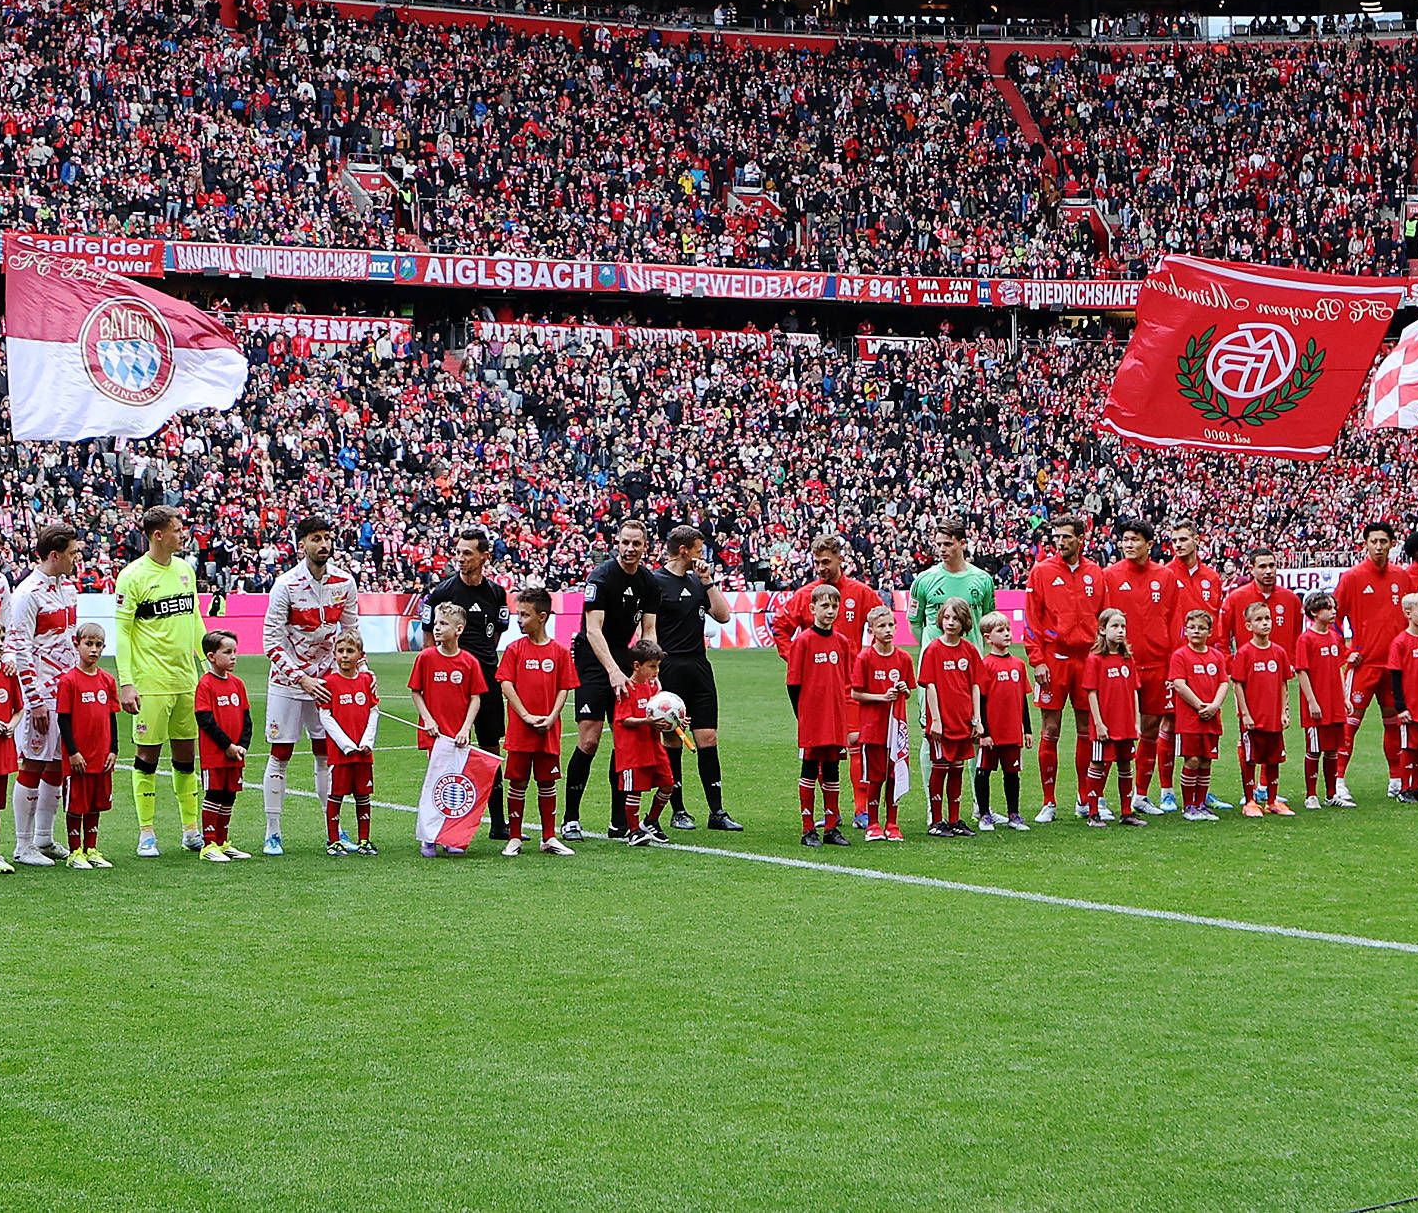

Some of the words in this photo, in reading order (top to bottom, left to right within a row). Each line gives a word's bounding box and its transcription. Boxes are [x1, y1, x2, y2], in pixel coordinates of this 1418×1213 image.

[94, 256, 152, 275] Power
[424, 258, 593, 289] AIGLSBACH
[626, 266, 824, 298] NIEDERWEIDBACH
[839, 278, 864, 296] AF
[869, 278, 893, 299] 94
[917, 280, 939, 290] MIA
[948, 280, 972, 290] SAN
[922, 292, 968, 303] ALLGÄU
[1024, 283, 1141, 306] FRIEDRICHSHAFE
[99, 307, 156, 340] BAYERN
[101, 379, 161, 403] MÜNCHEN
